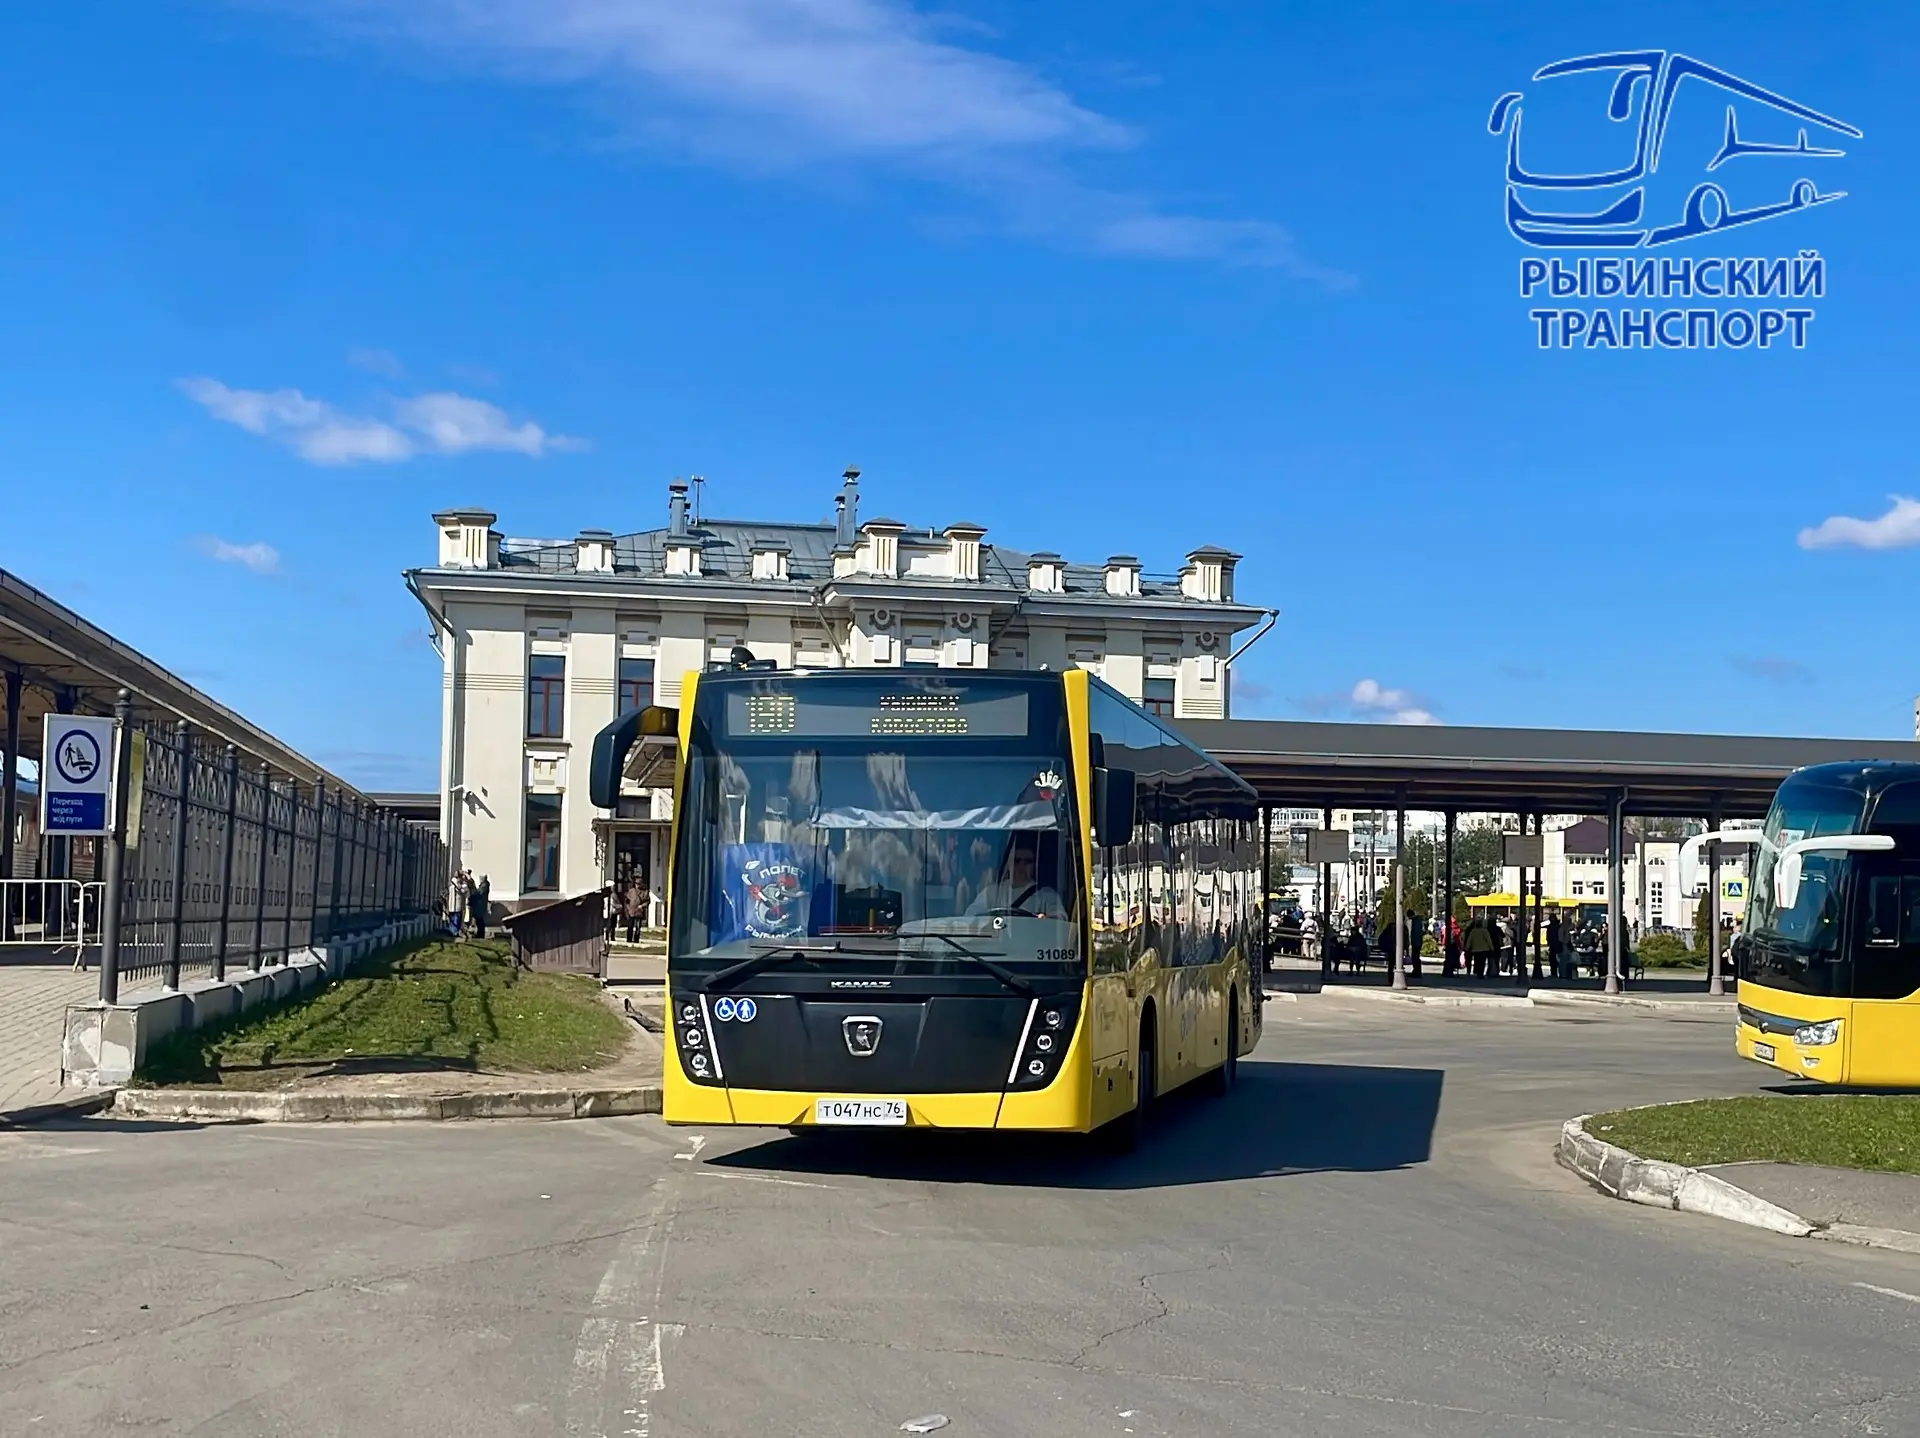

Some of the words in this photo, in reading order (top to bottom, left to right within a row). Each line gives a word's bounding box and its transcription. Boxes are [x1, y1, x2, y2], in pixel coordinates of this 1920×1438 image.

[880, 695, 960, 712] РЫБИНСК
[52, 797, 83, 806] Переход
[52, 807, 73, 815] через
[66, 816, 83, 824] пути
[760, 864, 806, 879] ПОЛЕТ
[1037, 949, 1076, 961] 31089
[831, 981, 892, 989] KAMAZ
